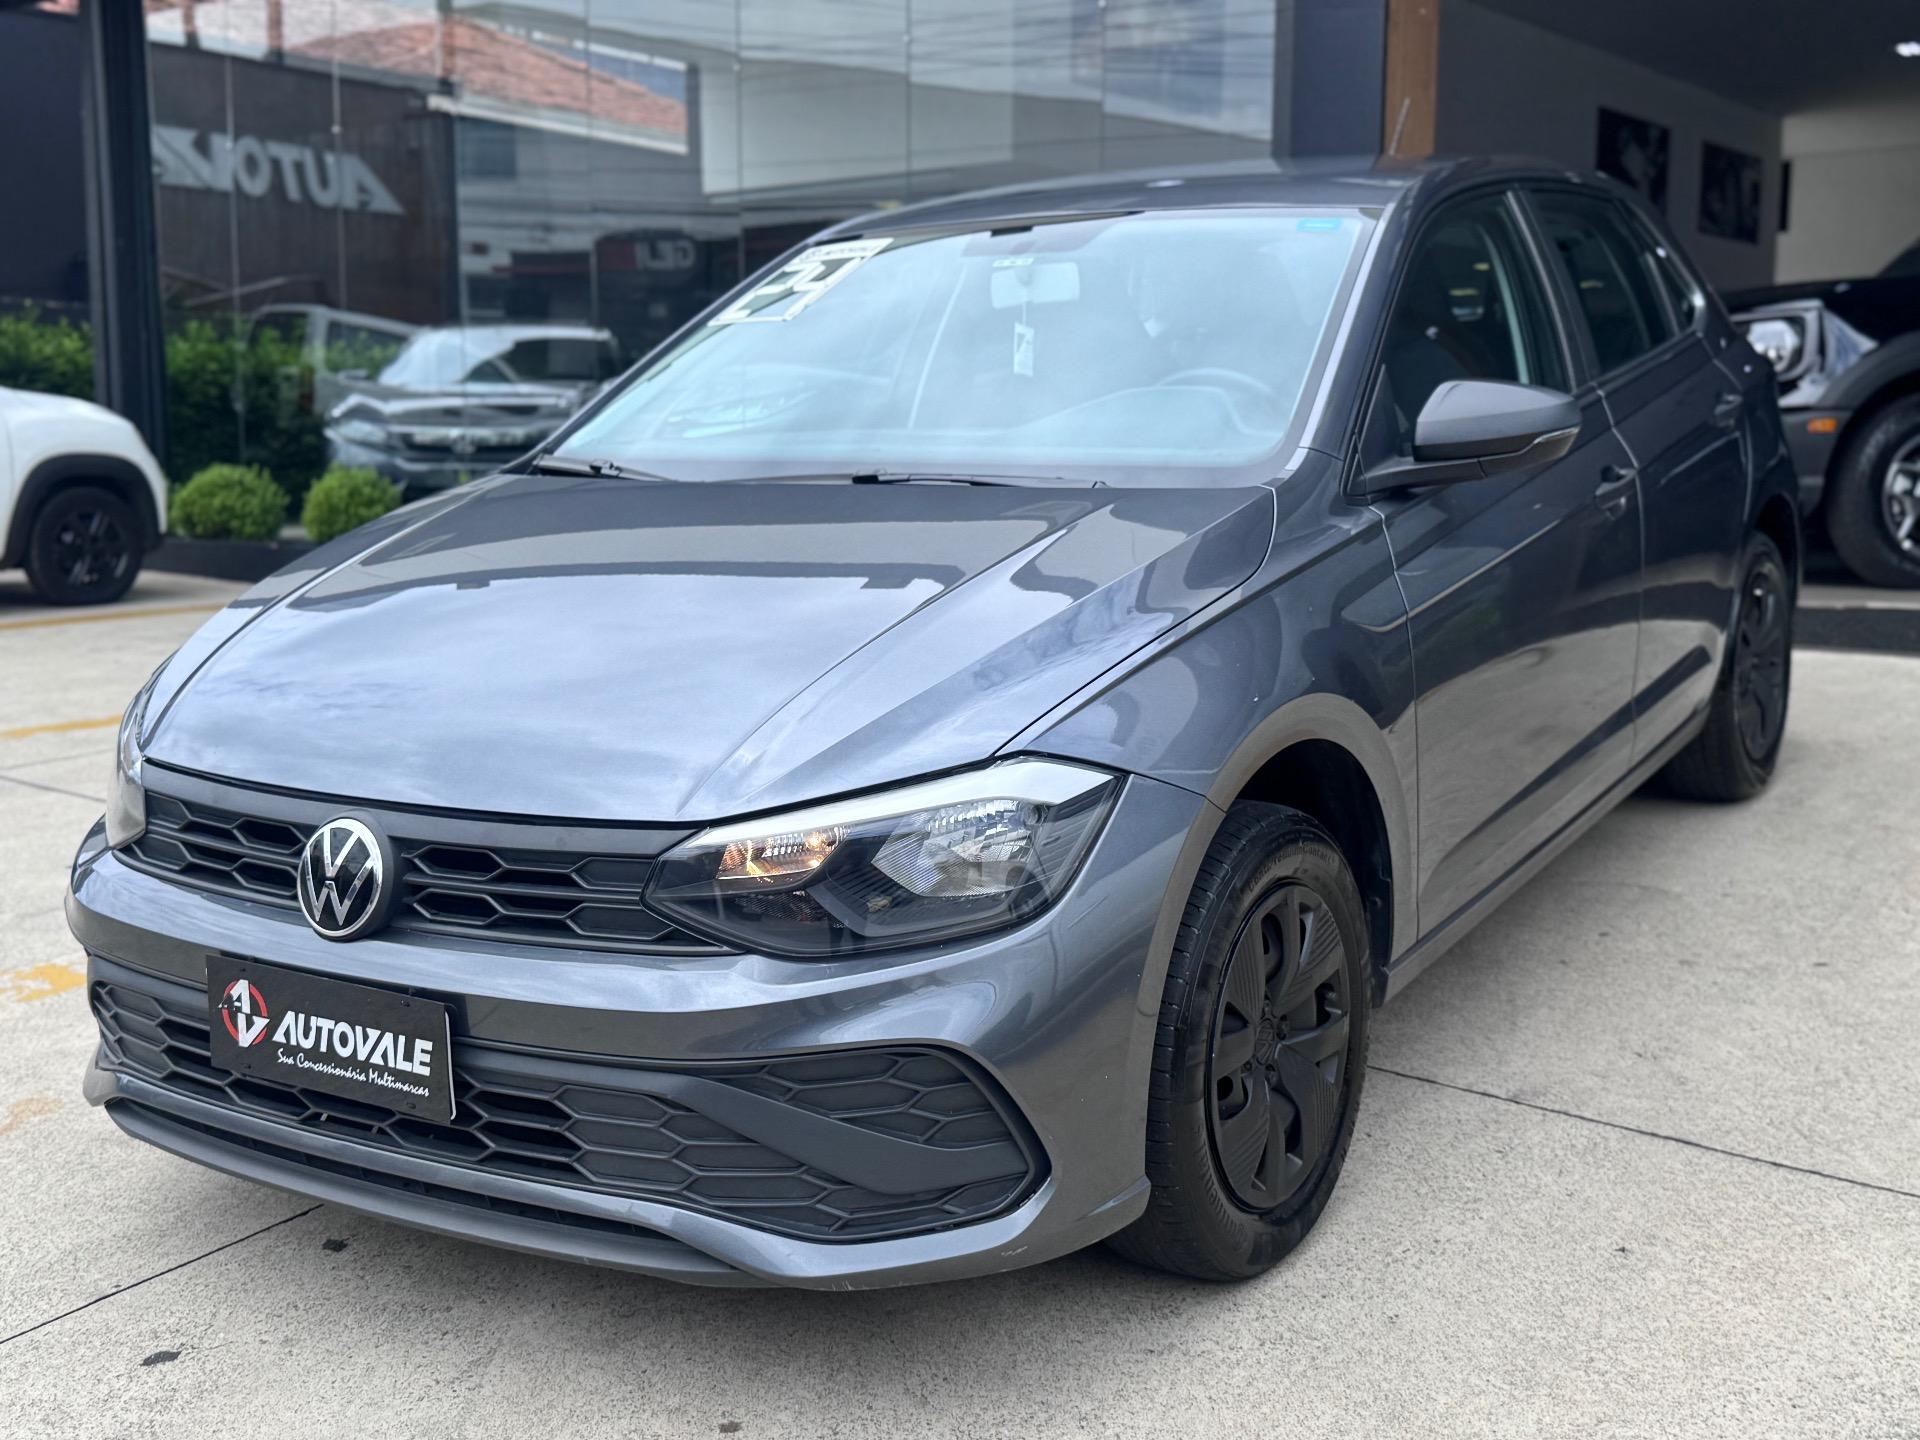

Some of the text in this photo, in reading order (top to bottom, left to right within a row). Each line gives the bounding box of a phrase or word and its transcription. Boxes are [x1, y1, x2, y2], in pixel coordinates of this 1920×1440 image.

[272, 1010, 433, 1076] AUTOVALE
[277, 1048, 430, 1097] Sua Concessionária Multimarcas
